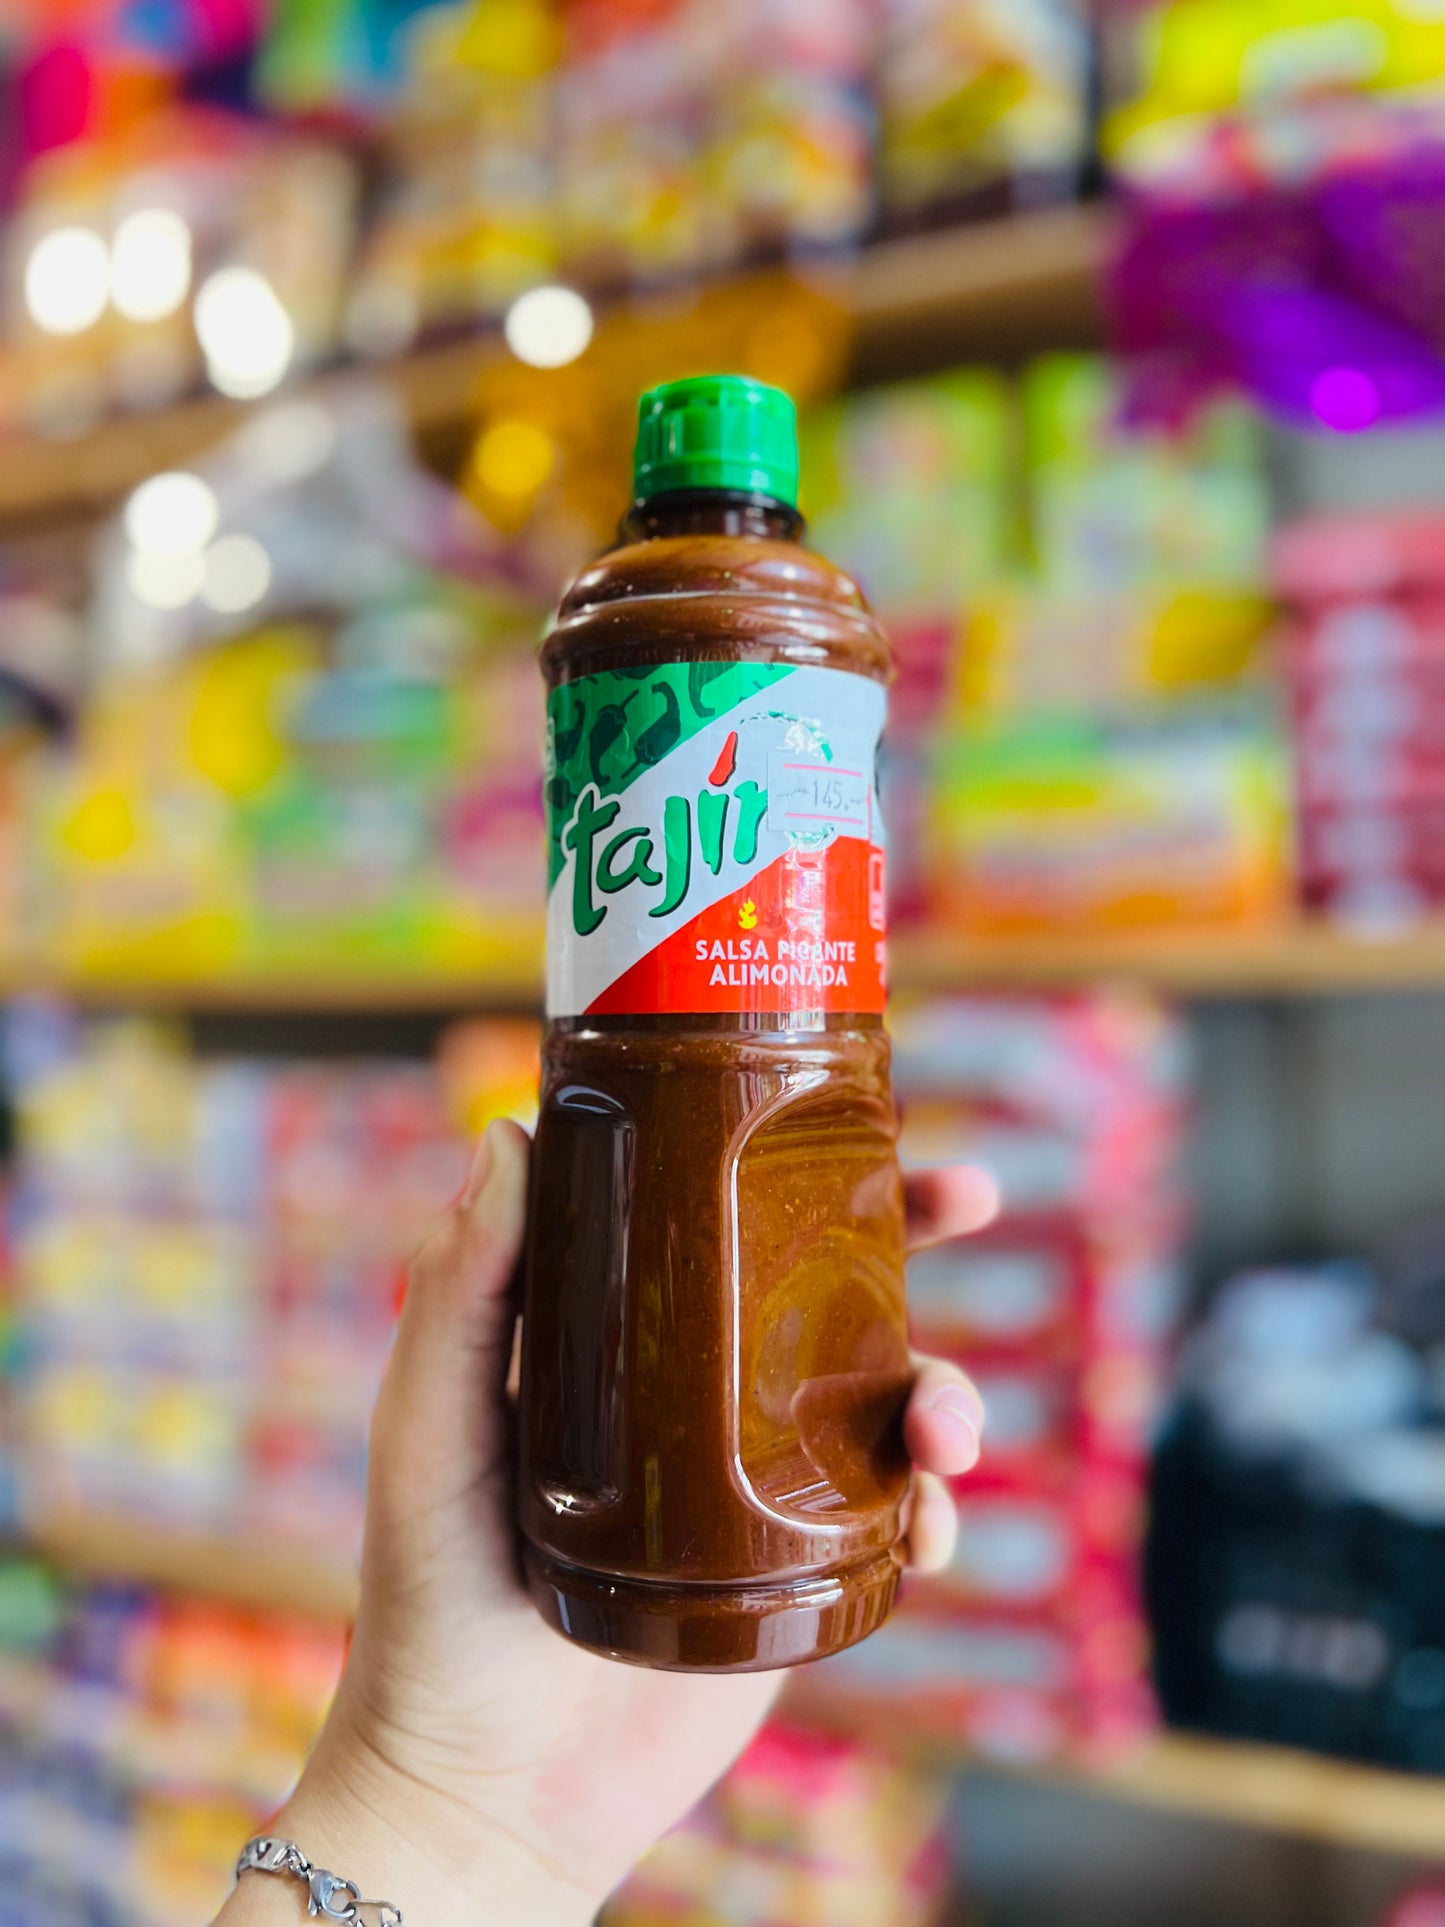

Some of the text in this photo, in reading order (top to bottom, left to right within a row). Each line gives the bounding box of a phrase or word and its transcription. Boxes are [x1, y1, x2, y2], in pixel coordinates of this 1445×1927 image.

[695, 939, 856, 962] SALSA PICANTE
[708, 963, 849, 987] ALIMONADA
